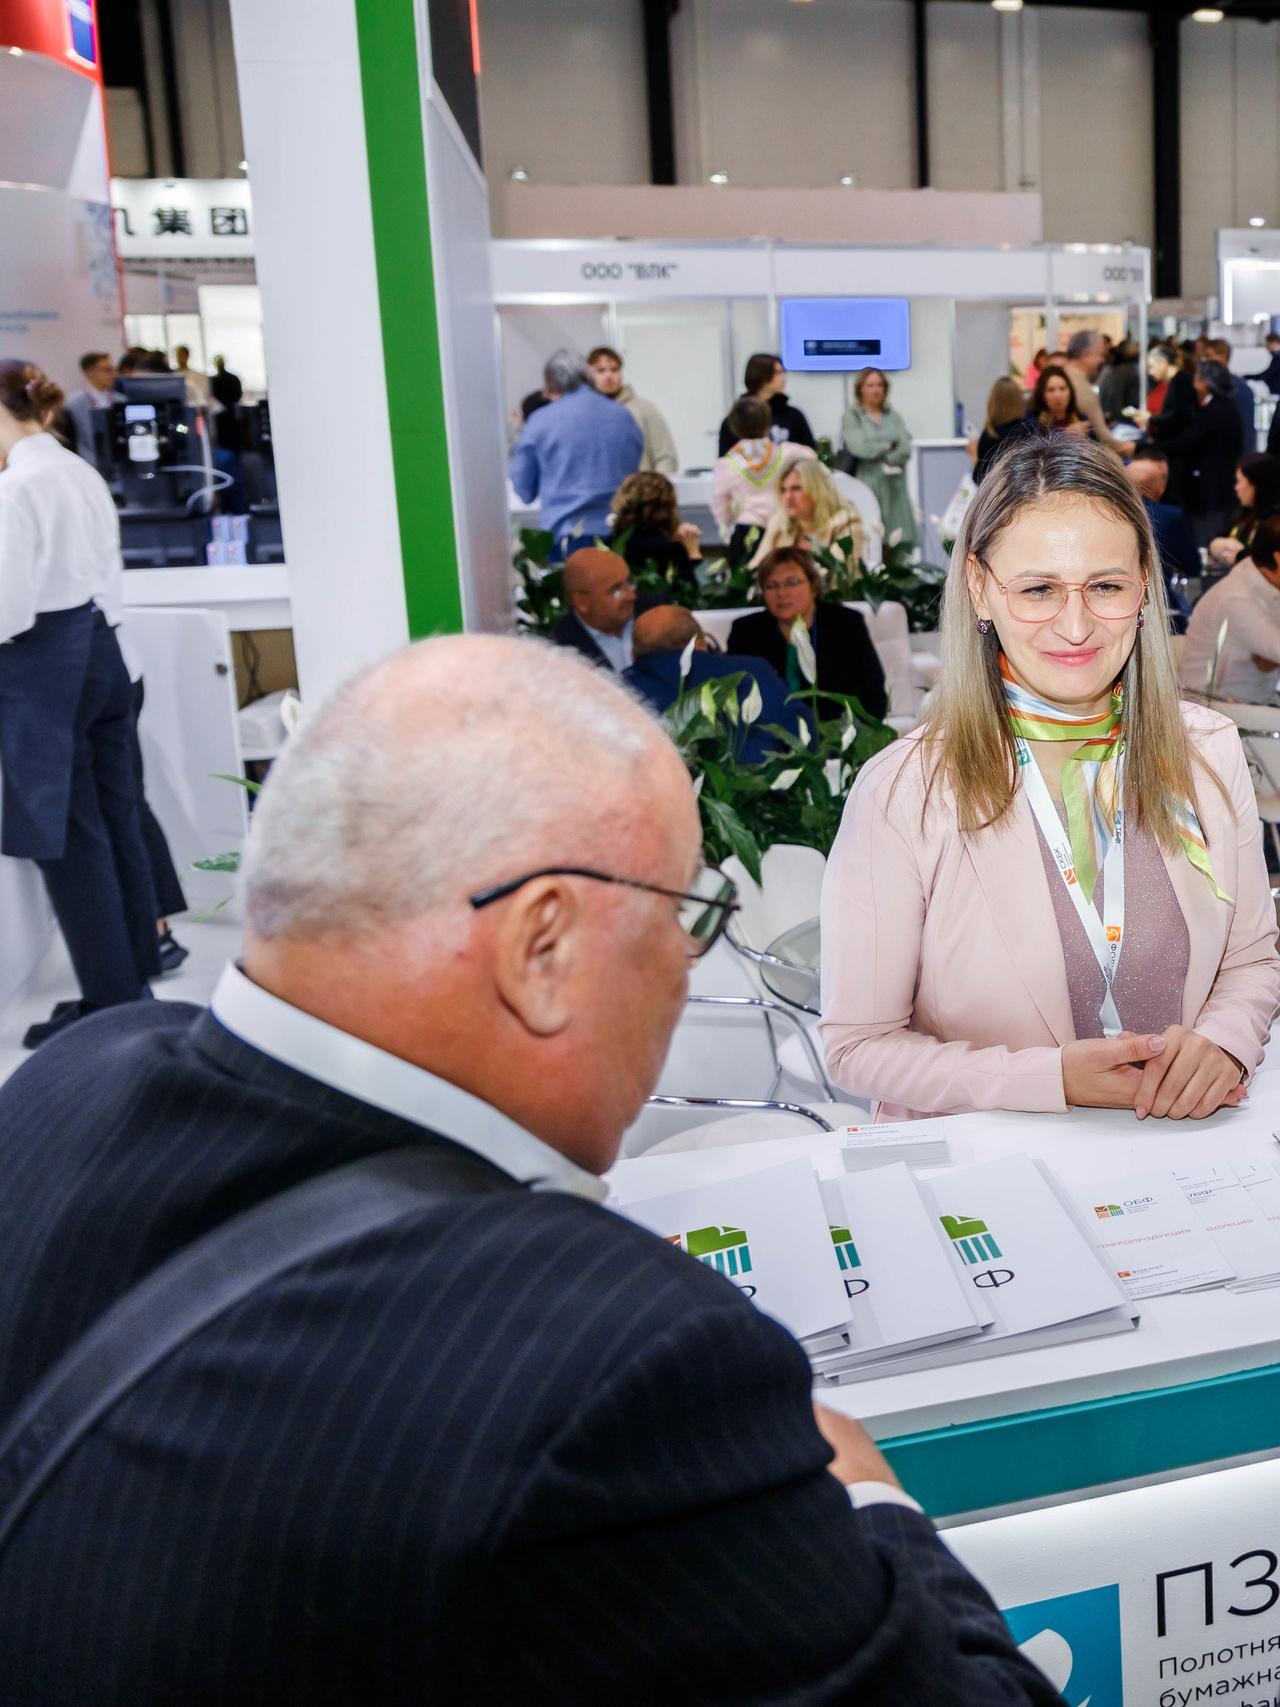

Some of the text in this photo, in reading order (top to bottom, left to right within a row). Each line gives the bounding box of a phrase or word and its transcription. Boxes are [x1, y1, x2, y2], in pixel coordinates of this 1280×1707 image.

[581, 262, 622, 280] ООО
[1053, 847, 1067, 869] СКБК
[1123, 1197, 1153, 1207] ОБФ
[1096, 1228, 1191, 1249] ГОФРОПРОДУКЦИЯ
